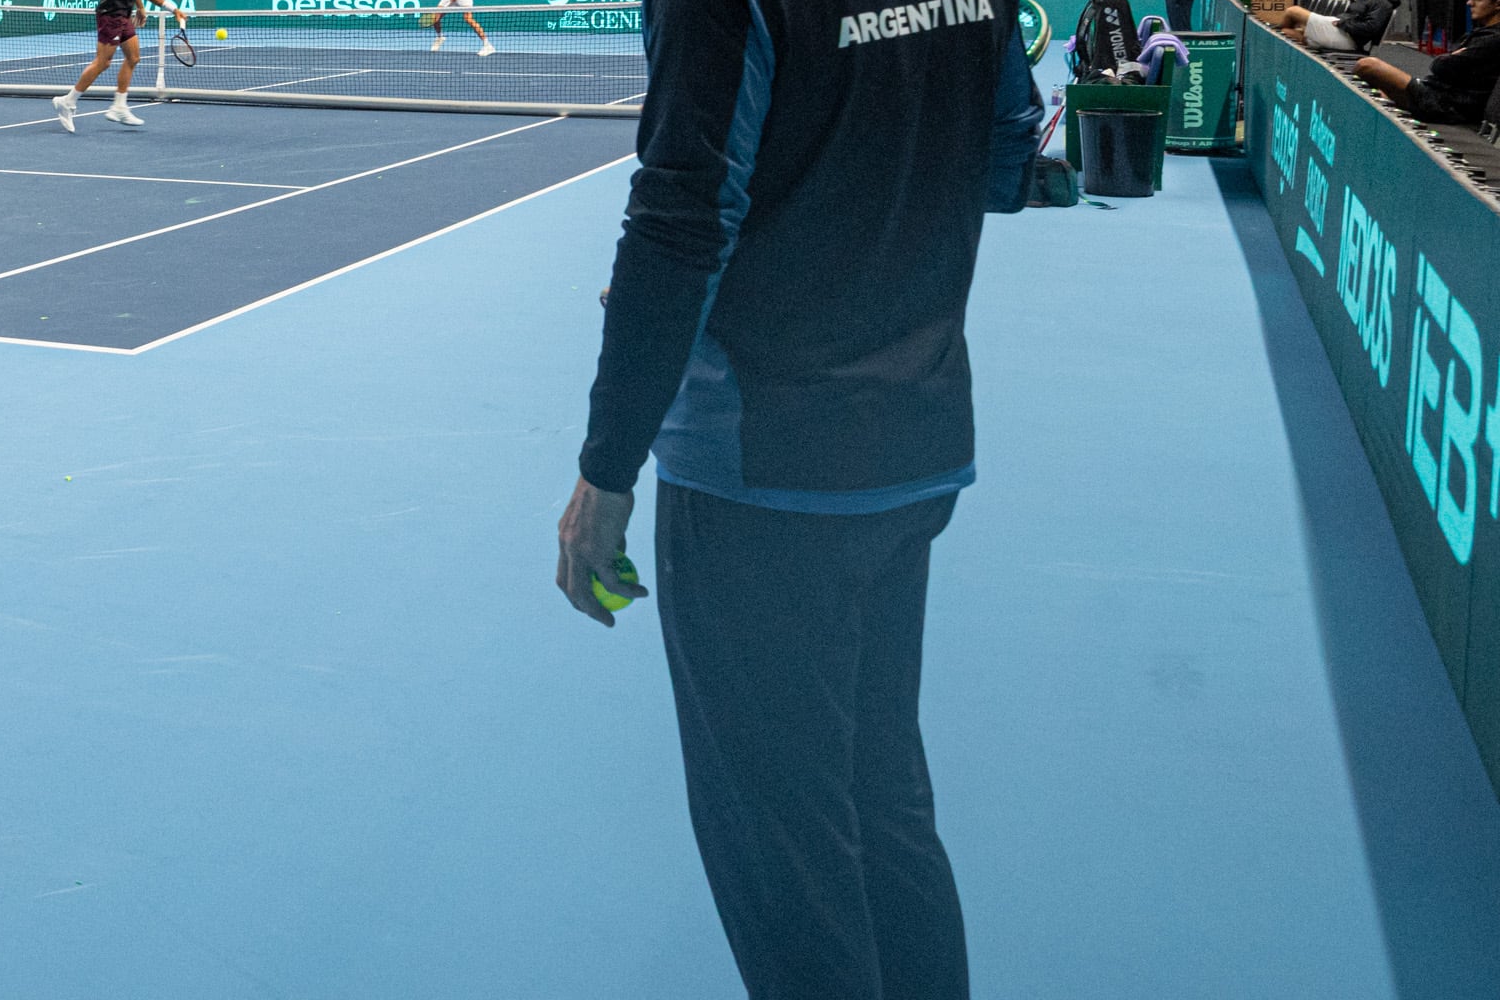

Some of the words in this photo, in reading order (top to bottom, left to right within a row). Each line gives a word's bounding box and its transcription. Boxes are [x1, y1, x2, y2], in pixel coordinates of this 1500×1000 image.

[547, 20, 557, 30] by
[1251, 2, 1285, 12] SUB
[1183, 59, 1204, 129] Wilson
[1336, 184, 1397, 389] MEDICUS
